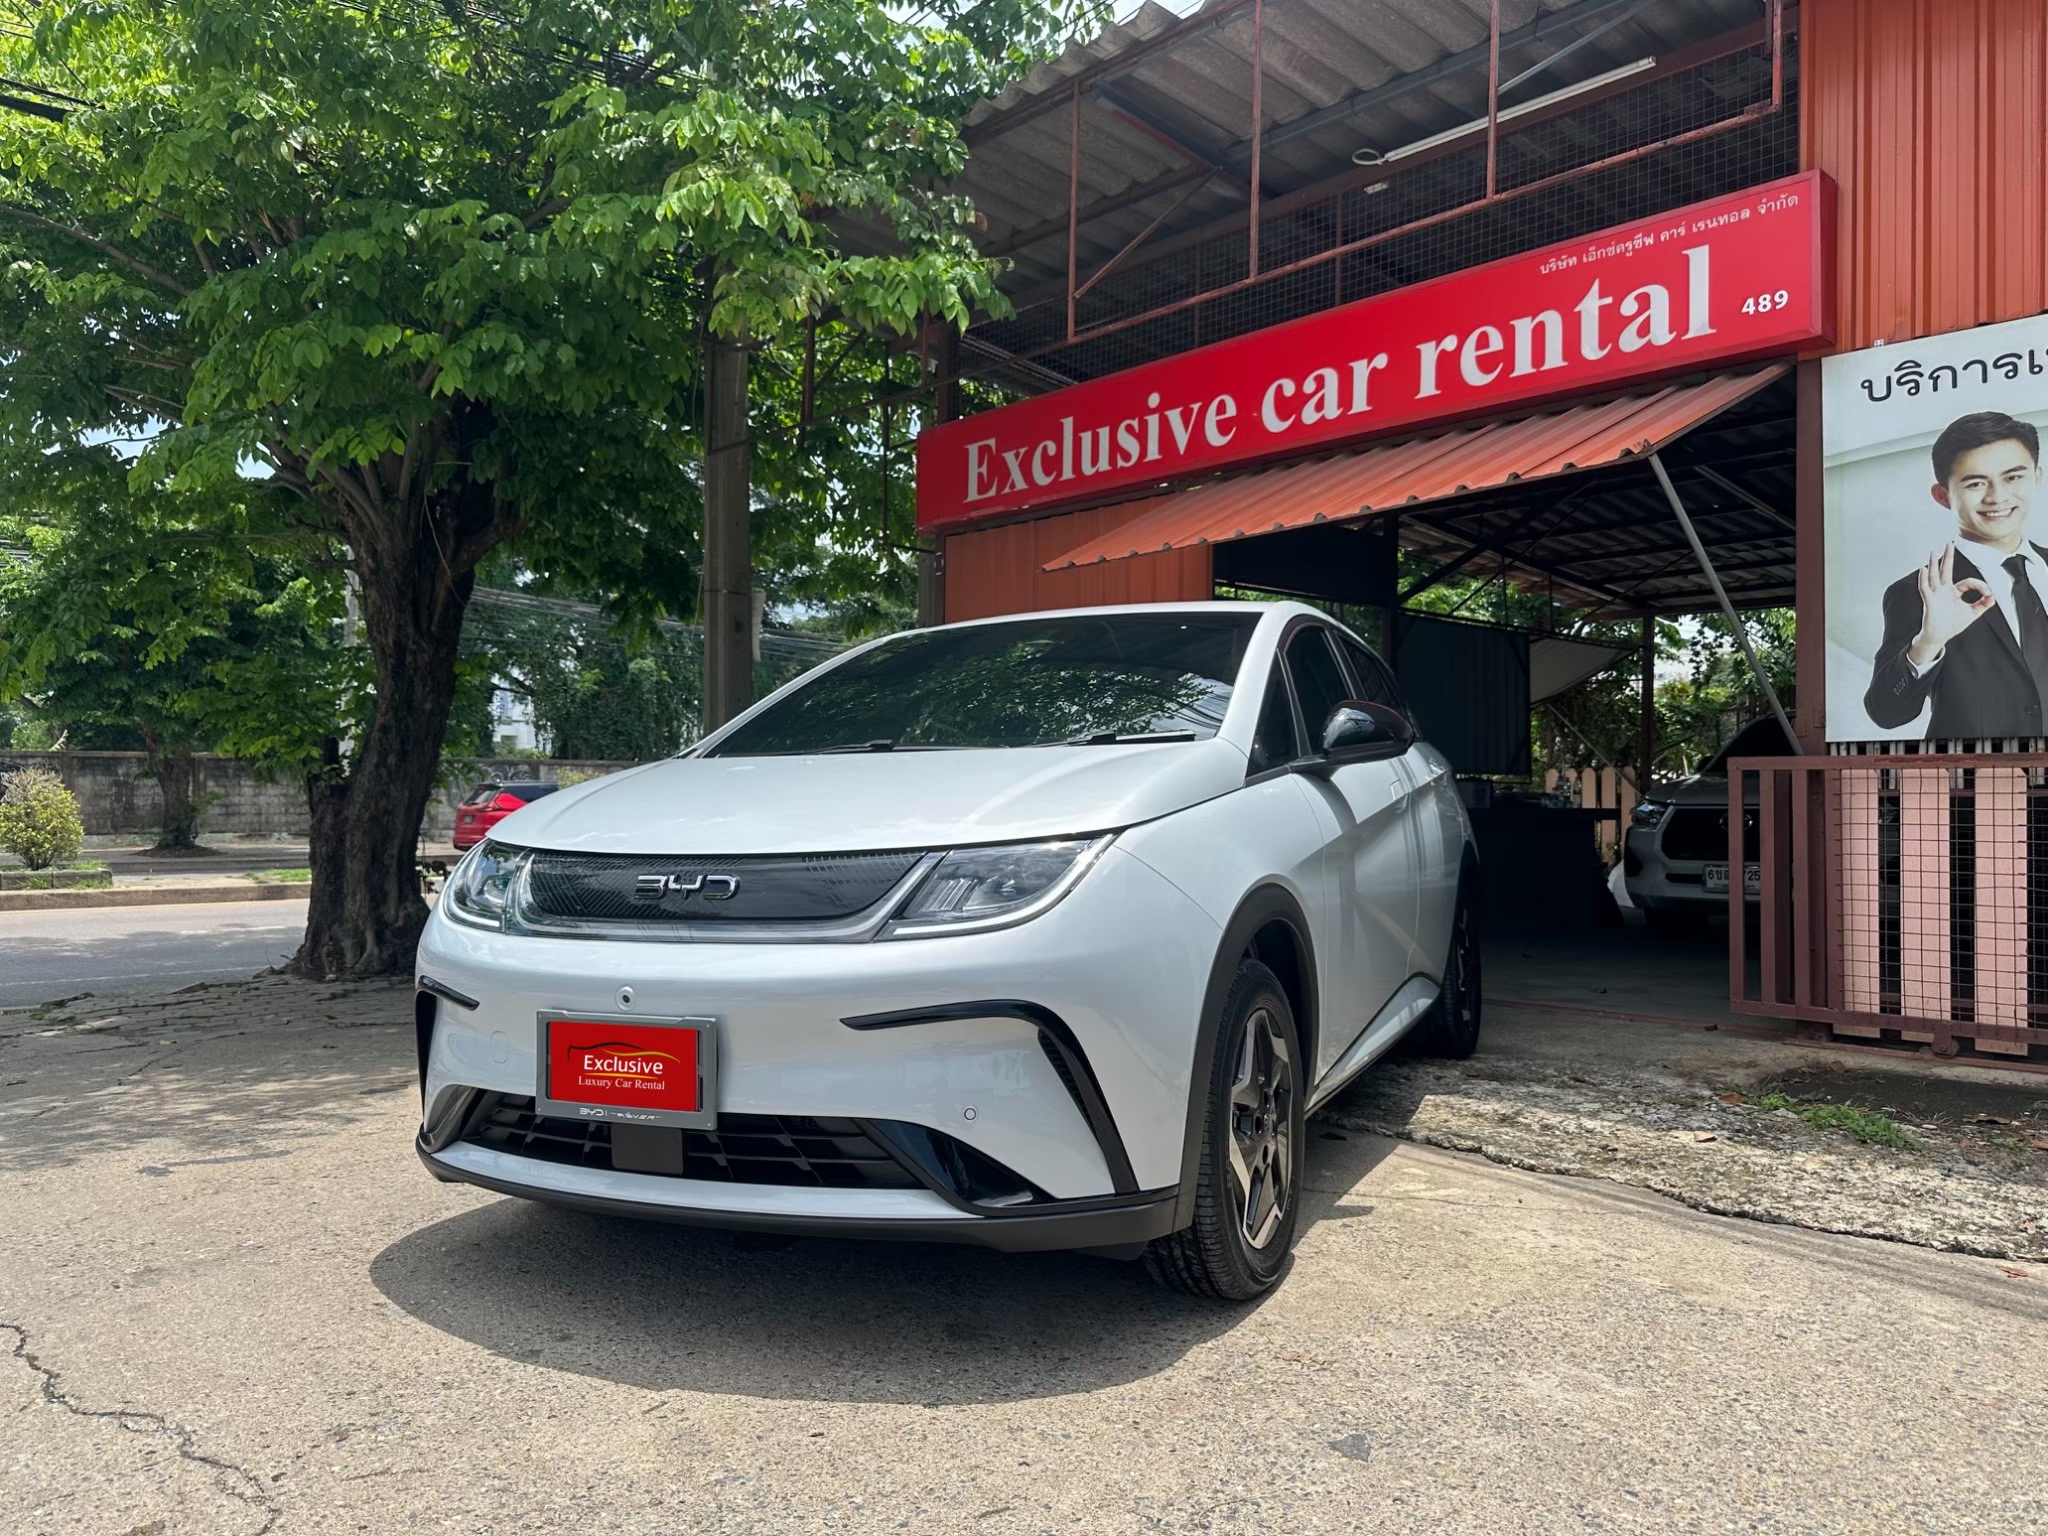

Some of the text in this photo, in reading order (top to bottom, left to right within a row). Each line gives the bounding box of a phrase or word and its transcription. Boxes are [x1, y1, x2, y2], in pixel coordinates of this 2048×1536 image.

[1540, 254, 1577, 274] บริษัท
[1660, 221, 1686, 242] คาร์
[1692, 208, 1750, 232] เรนทอล
[1757, 193, 1799, 215] จำกัด
[1741, 290, 1789, 316] 489
[963, 244, 1717, 504] Exclusive car rental
[1860, 348, 2048, 402] บริการเ
[634, 874, 739, 900] BYD
[583, 1054, 663, 1075] Exclusive
[578, 1075, 665, 1090] Luxury Car Rental
[579, 1107, 604, 1117] BYD
